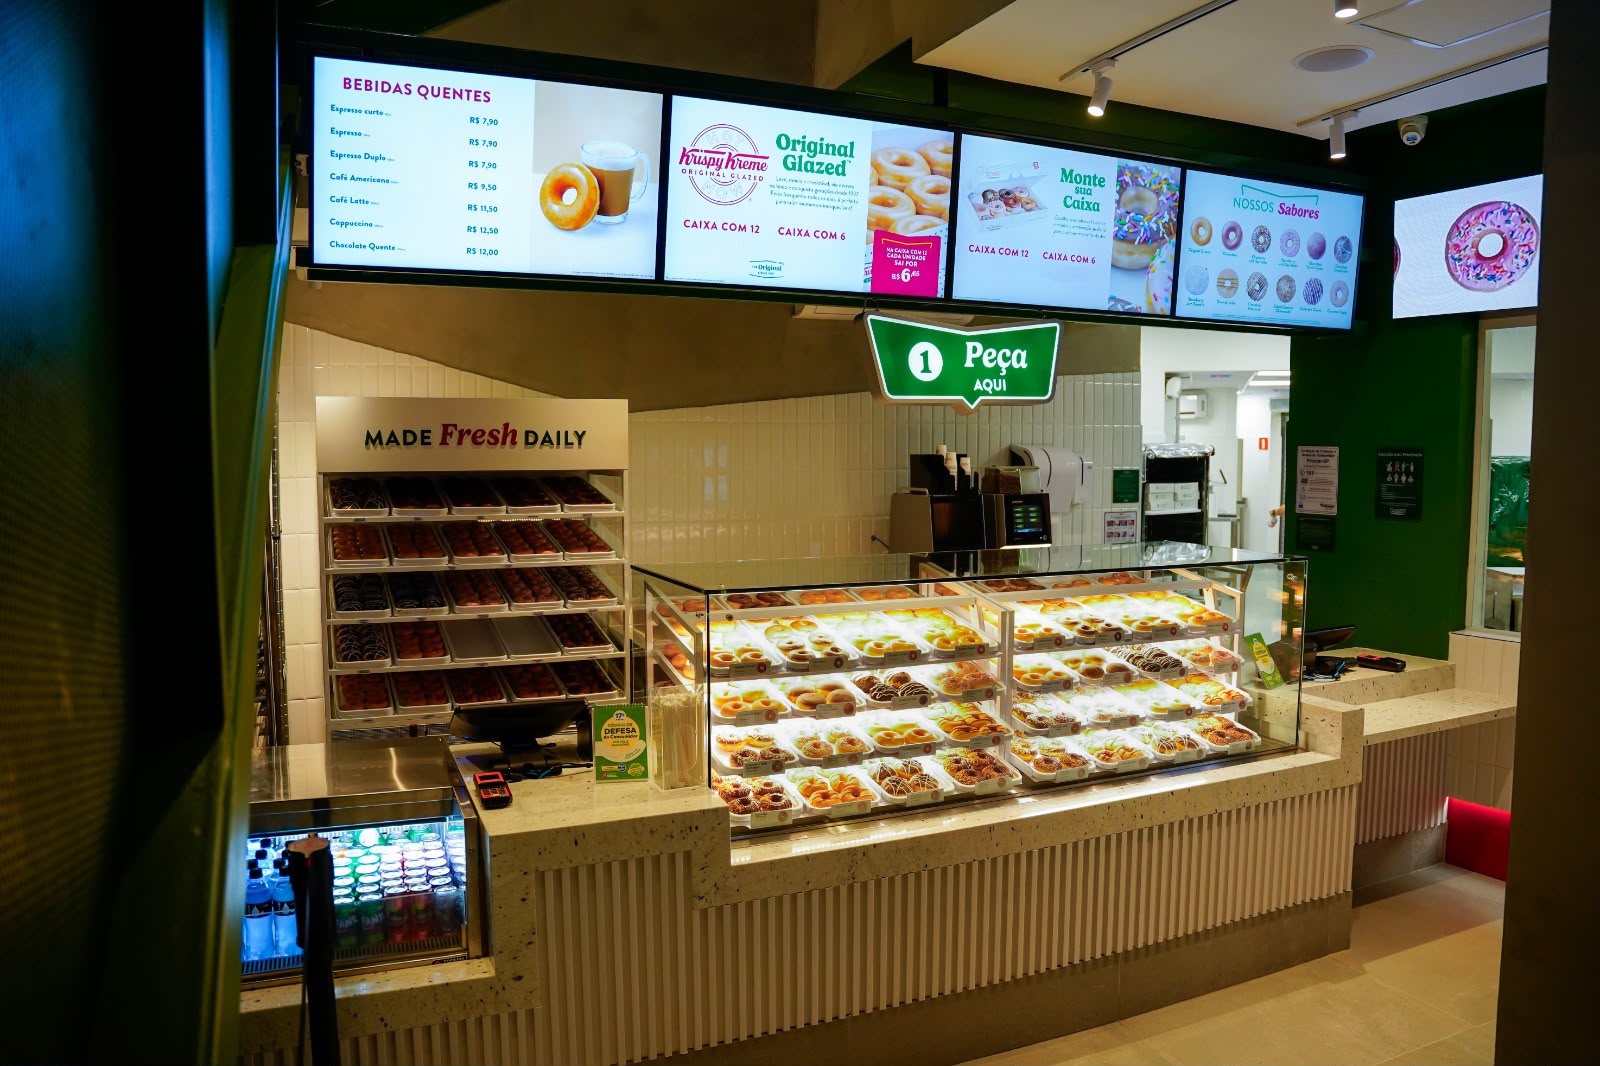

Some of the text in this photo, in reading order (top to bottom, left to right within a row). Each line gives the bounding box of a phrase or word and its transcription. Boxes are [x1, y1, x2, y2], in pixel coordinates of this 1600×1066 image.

[343, 77, 491, 103] BEBIDAS QUENTES
[330, 104, 362, 115] Espresso
[364, 108, 384, 116] curto
[470, 116, 499, 127] R$ 7,90
[330, 127, 362, 138] Espresso
[469, 138, 498, 148] R$ 7,90
[776, 133, 855, 159] Original
[330, 150, 362, 160] Espresso
[363, 153, 386, 162] Duplo
[679, 146, 770, 172] Krispy Kreme
[468, 160, 497, 170] R$ 7,90
[330, 173, 390, 184] Café Americano
[681, 168, 764, 182] ORIGINAL GLAZED
[1060, 168, 1106, 188] Monte
[468, 182, 497, 192] R$ 9,50
[1074, 186, 1092, 196] sua
[330, 195, 348, 204] Café
[350, 197, 370, 205] Latte
[1063, 195, 1100, 212] Caixa
[468, 204, 498, 214] R$ 11,50
[1233, 197, 1320, 219] NOSSOS Sabores
[330, 218, 373, 229] Cappuccino
[683, 219, 760, 234] CAIXA COM 12
[467, 226, 498, 235] R$ 12,50
[778, 226, 846, 241] CAIXA COM 6
[330, 240, 396, 252] Chocolate Quente
[466, 247, 499, 257] R$ 12,00
[968, 244, 1029, 258] CAIXA COM 12
[1042, 252, 1096, 264] CAIXA COM 6
[758, 264, 782, 272] Original
[920, 341, 1028, 376] 1 Peça
[973, 378, 1006, 394] AQUI
[365, 422, 586, 446] MADE Fresh DAILY
